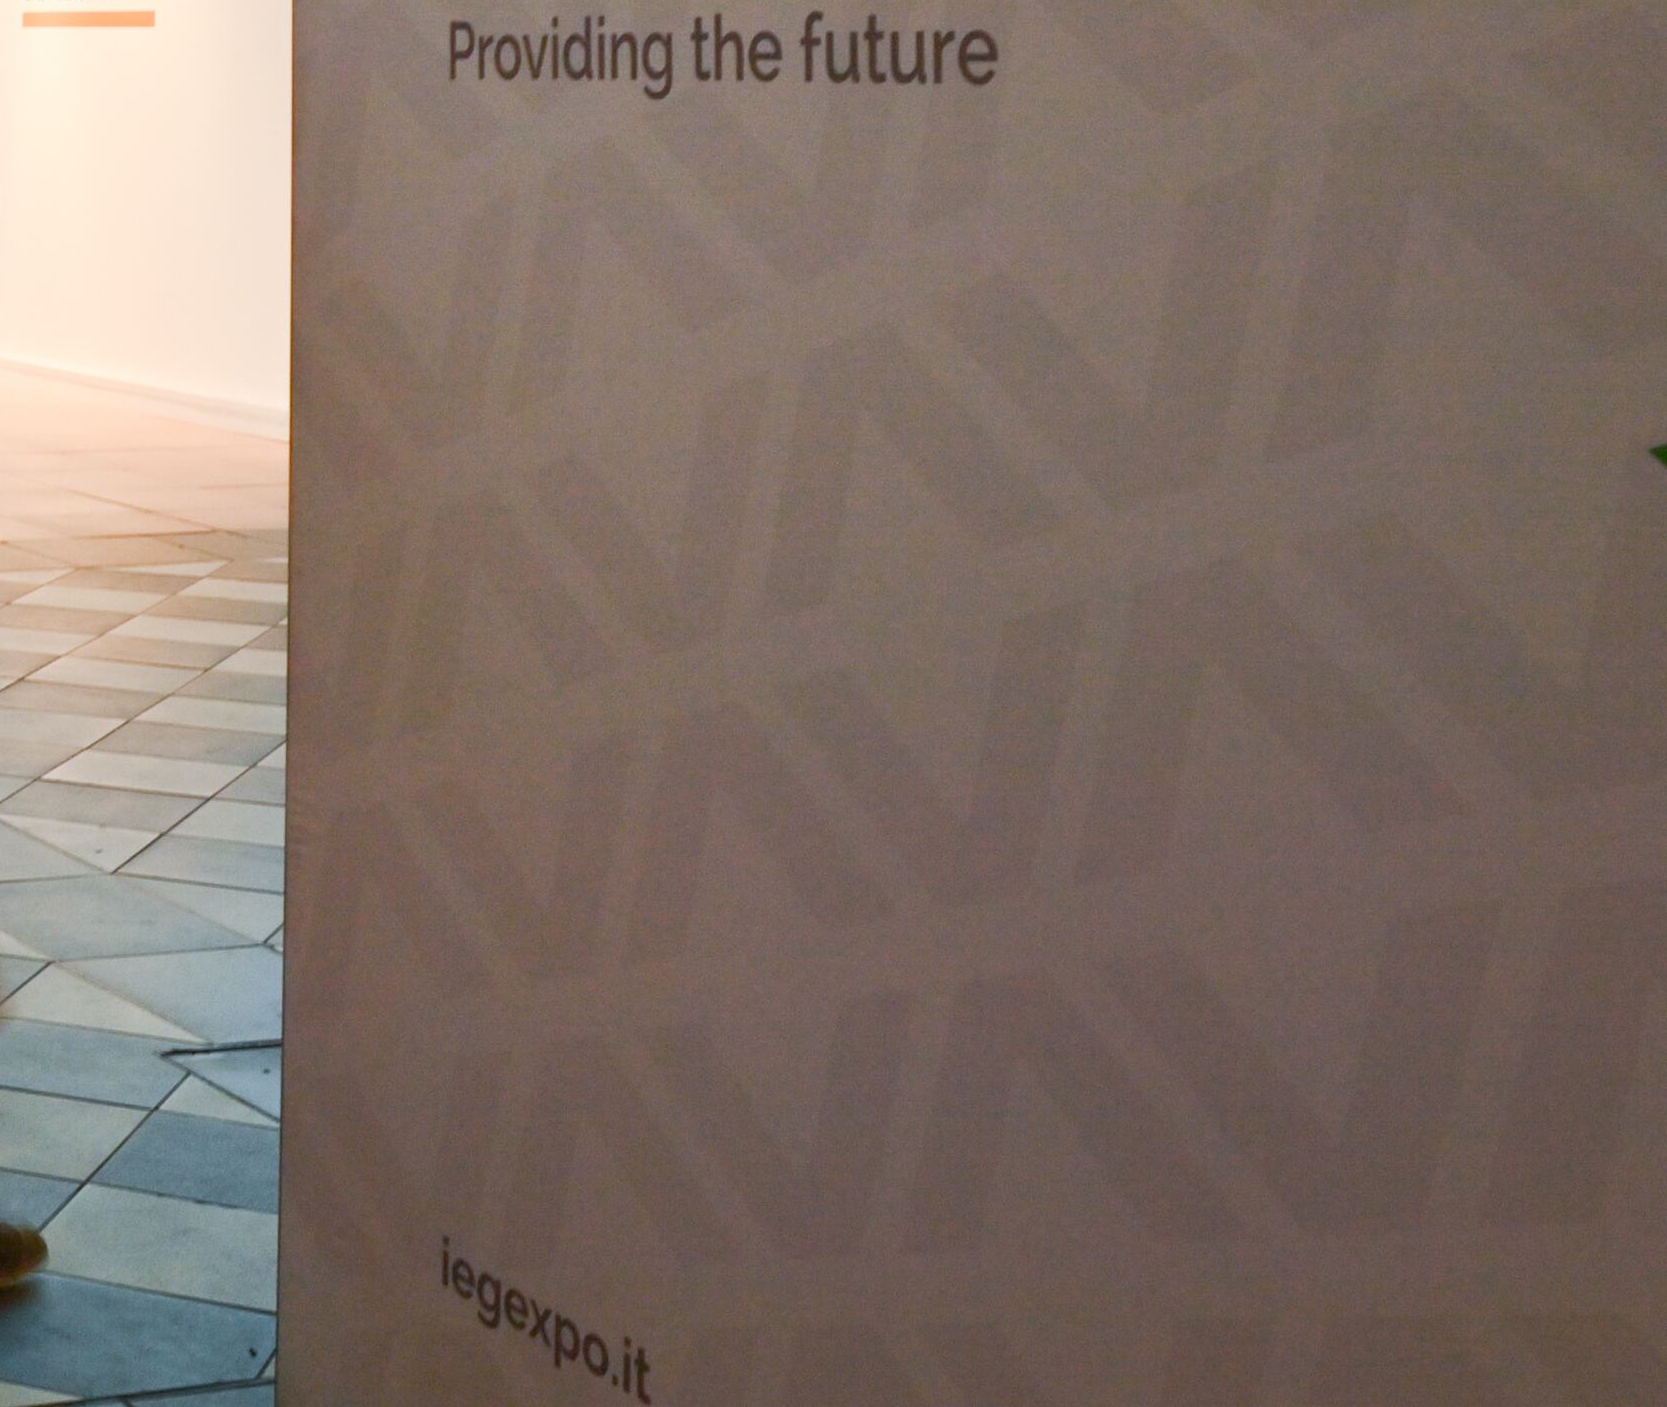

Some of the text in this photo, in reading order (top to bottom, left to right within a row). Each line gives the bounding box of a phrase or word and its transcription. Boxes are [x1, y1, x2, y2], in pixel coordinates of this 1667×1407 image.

[449, 11, 999, 100] Providing the future
[441, 1235, 651, 1405] iegexpo.it
